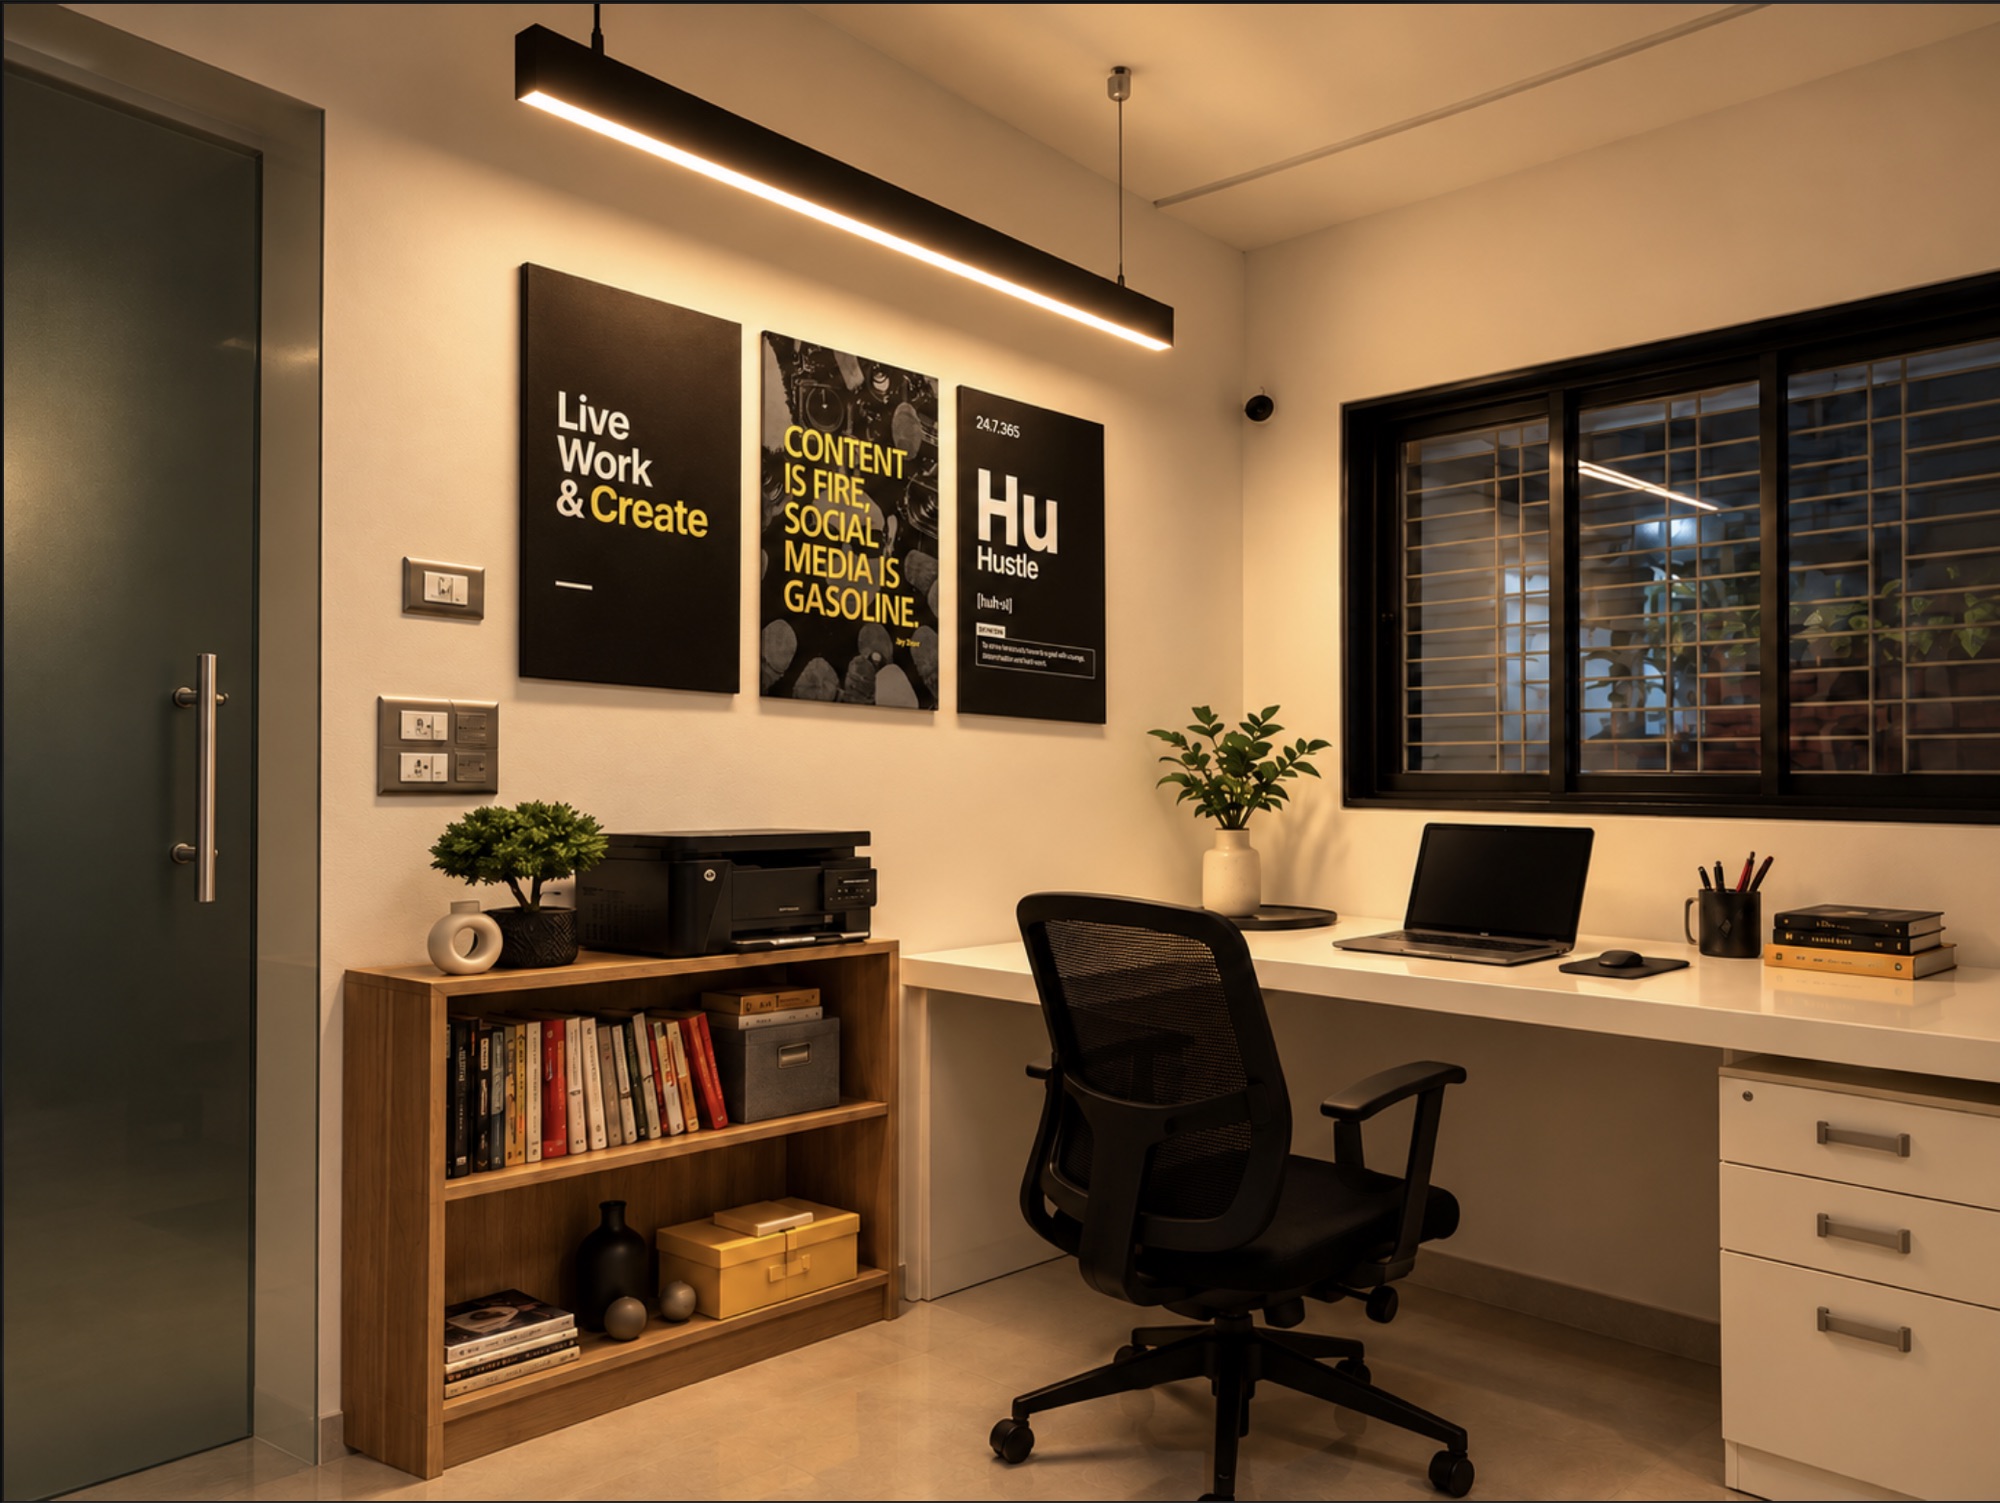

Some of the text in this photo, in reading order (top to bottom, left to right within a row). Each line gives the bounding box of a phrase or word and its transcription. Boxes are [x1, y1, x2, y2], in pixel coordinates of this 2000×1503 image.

[556, 389, 630, 441] Live
[976, 414, 1021, 439] 24.7.365
[556, 433, 653, 488] Work
[783, 424, 908, 480] CONTENT
[556, 478, 708, 538] & Create
[785, 462, 871, 514] IS FIRE,
[977, 467, 1058, 556] Hu
[784, 500, 879, 548] SOCIAL
[784, 540, 900, 588] MEDIA IS
[977, 545, 1039, 580] Hustle
[783, 580, 919, 628] GASOLINE.
